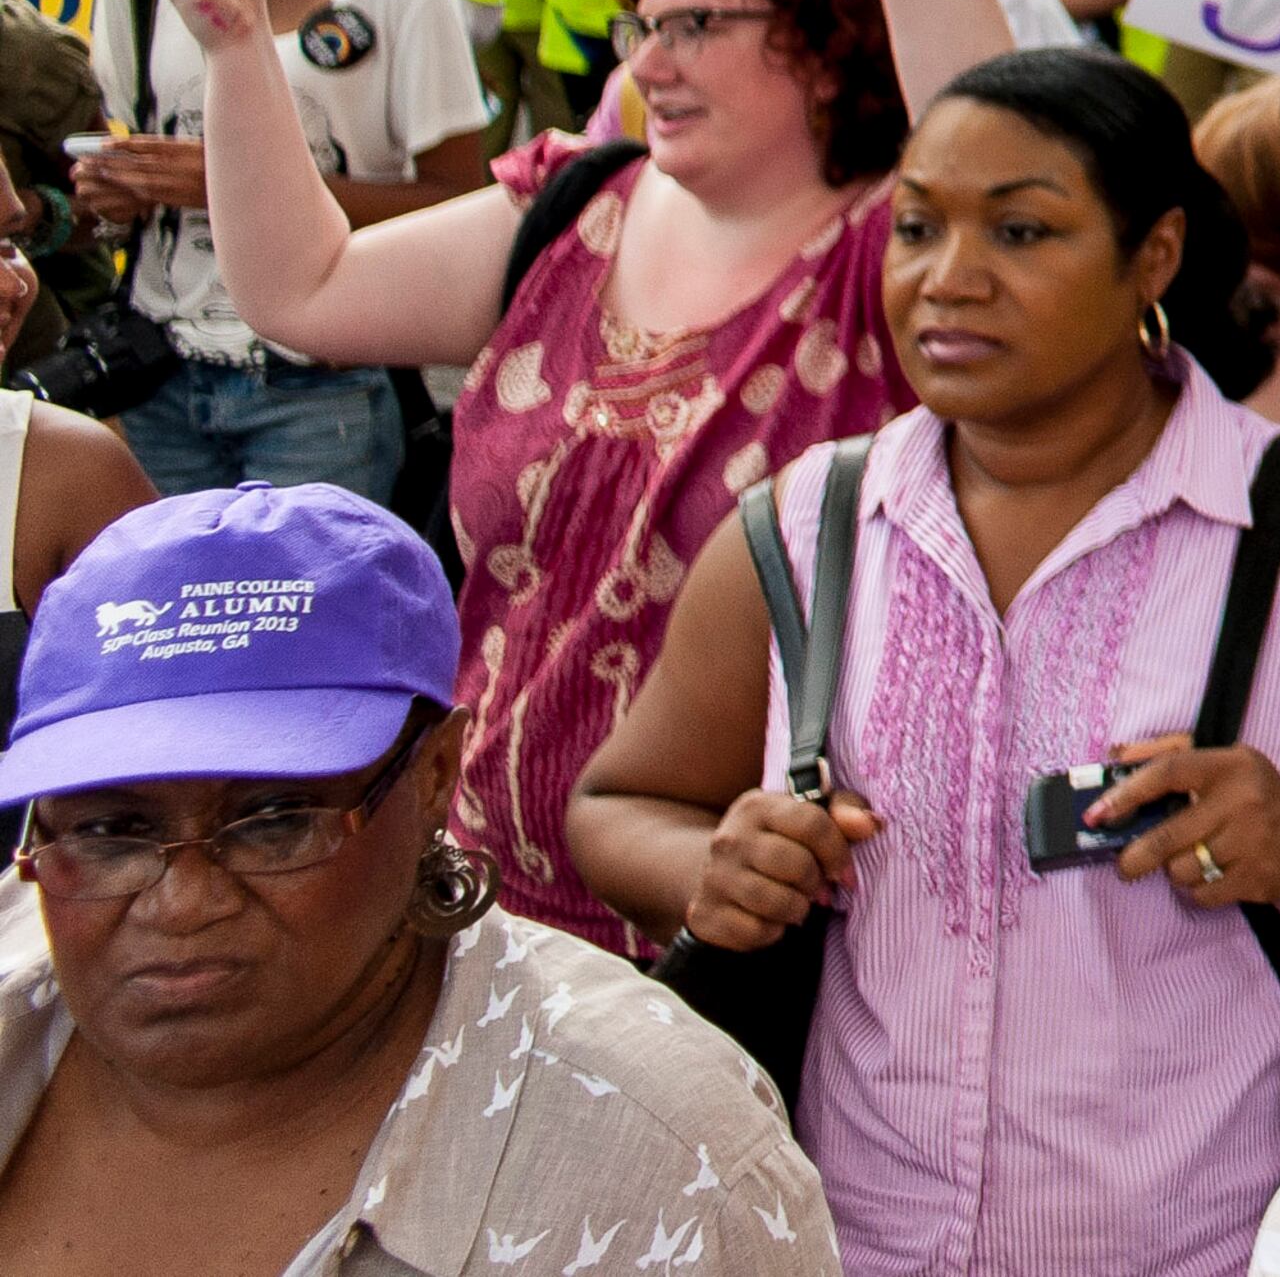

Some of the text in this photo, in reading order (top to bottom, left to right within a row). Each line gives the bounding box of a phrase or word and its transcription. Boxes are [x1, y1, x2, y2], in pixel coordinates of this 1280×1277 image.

[180, 579, 317, 599] PAINE COLLEGE
[178, 595, 315, 620] ALUMNI
[132, 626, 176, 646] Class
[177, 619, 250, 638] Reunion
[252, 615, 300, 633] 2013
[221, 633, 250, 650] GA
